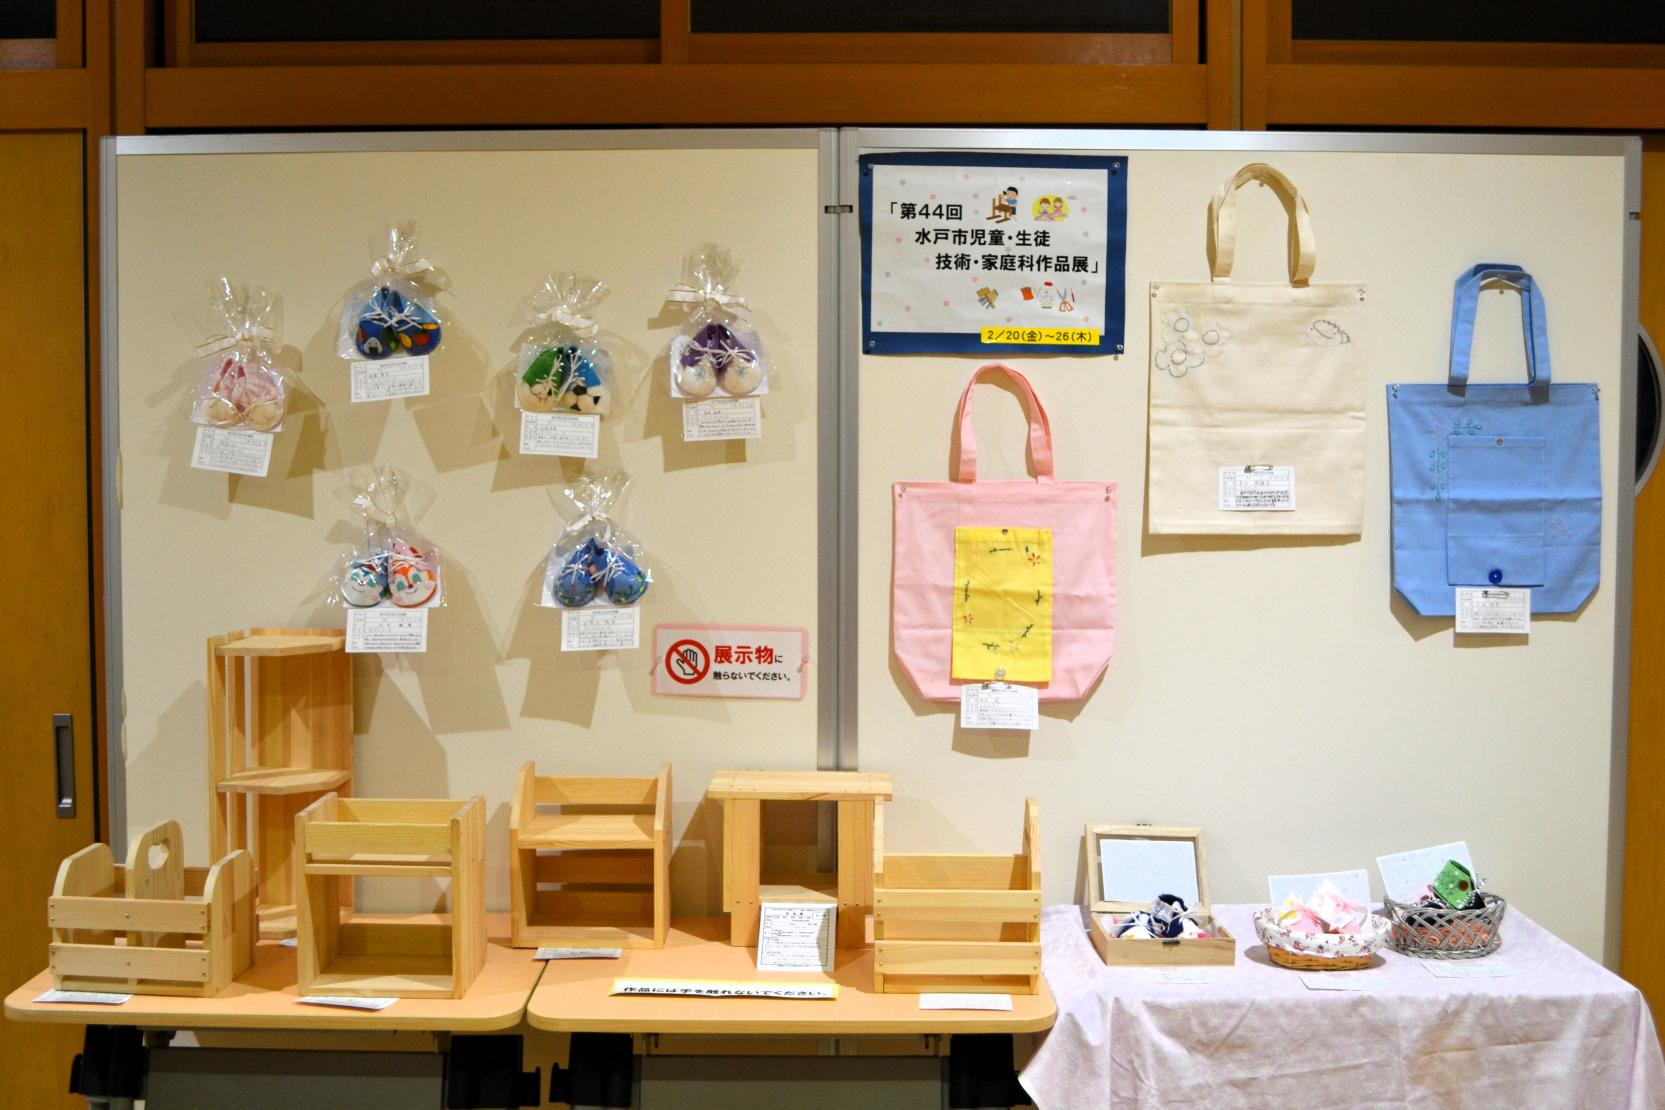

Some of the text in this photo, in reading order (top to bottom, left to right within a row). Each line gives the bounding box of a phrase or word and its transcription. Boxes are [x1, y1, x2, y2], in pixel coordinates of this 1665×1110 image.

[890, 201, 963, 221] 「第44回
[915, 228, 1051, 247] 水戸市児童・生徒
[935, 252, 1099, 274] 技術・家庭科作品展」
[714, 645, 783, 664] 展示物に
[712, 671, 791, 682] 触らないでください。
